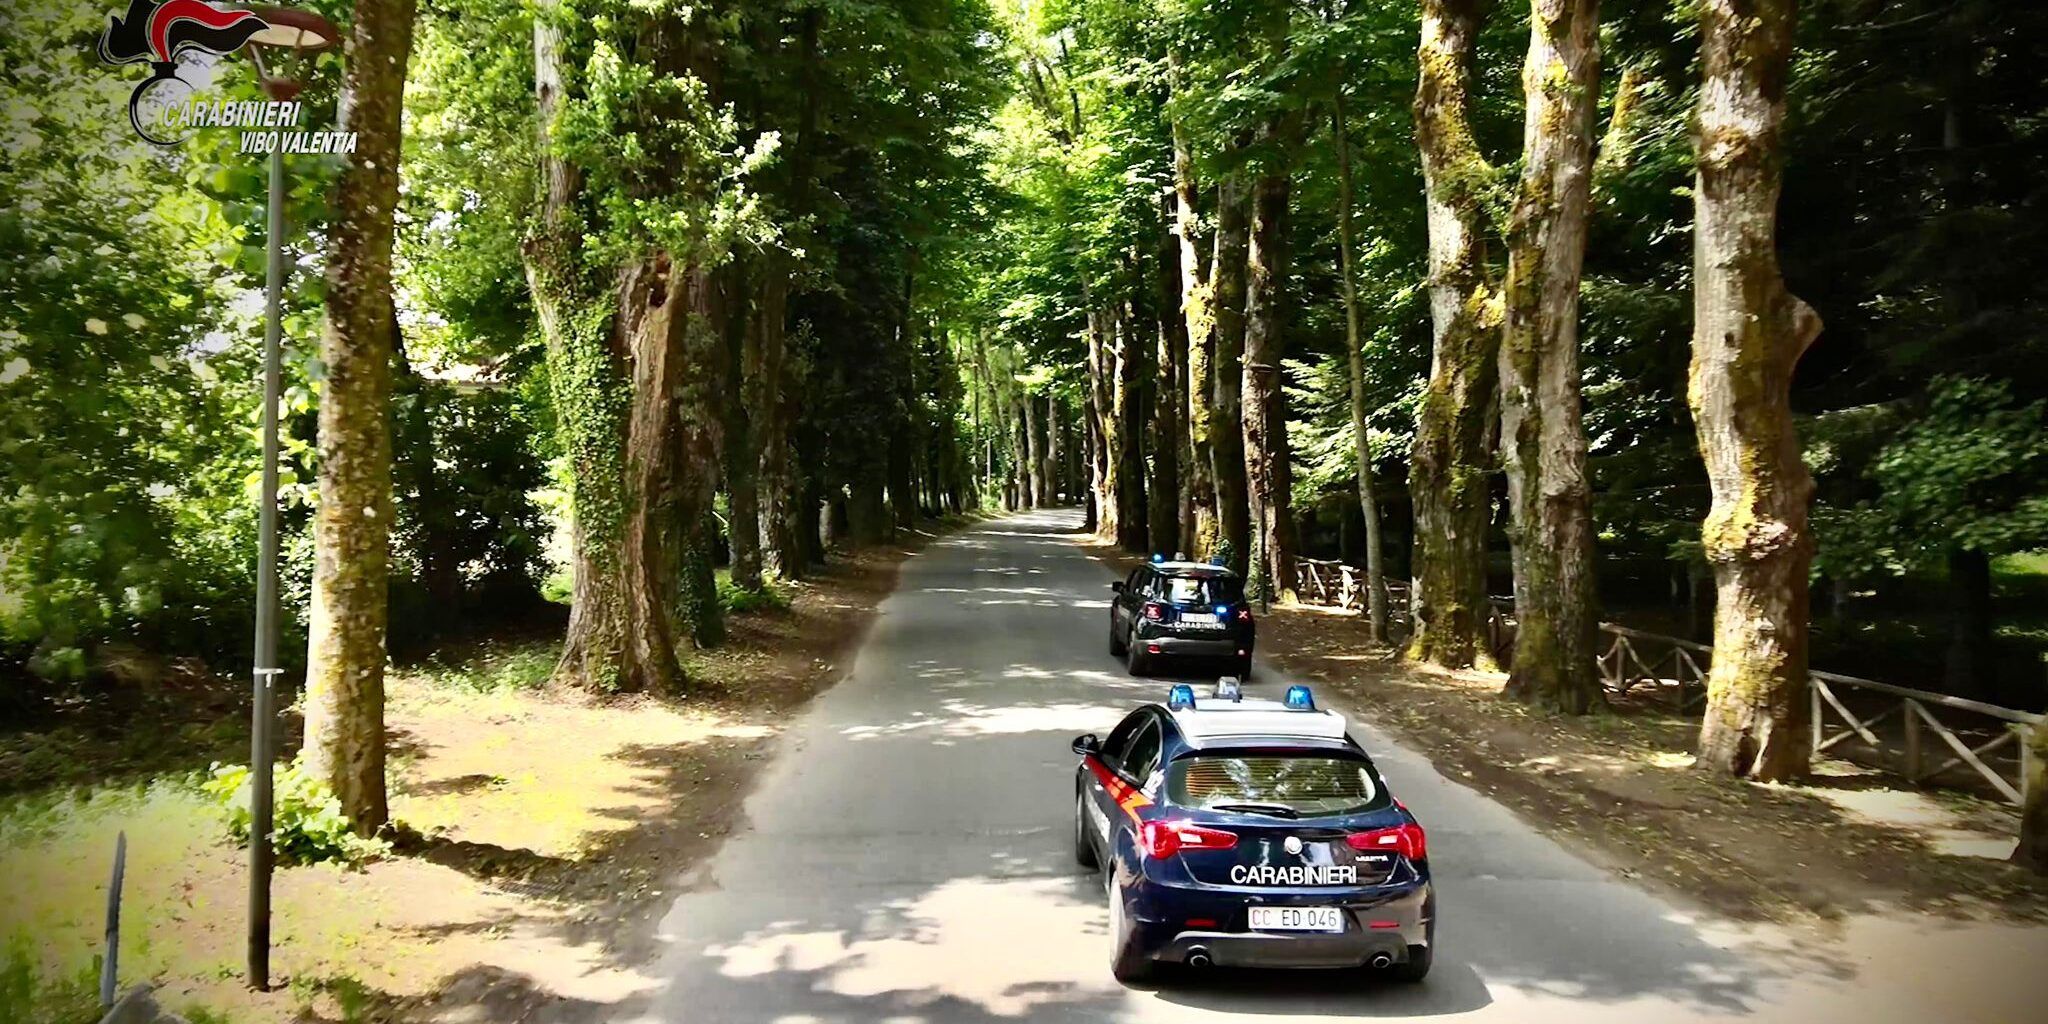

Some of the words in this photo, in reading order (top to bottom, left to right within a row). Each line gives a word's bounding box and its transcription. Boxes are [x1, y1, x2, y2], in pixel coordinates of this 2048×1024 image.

[1231, 865, 1357, 885] CARABINIERI
[1252, 909, 1271, 926] CC
[1282, 909, 1300, 926] ED
[1308, 910, 1337, 927] 046
